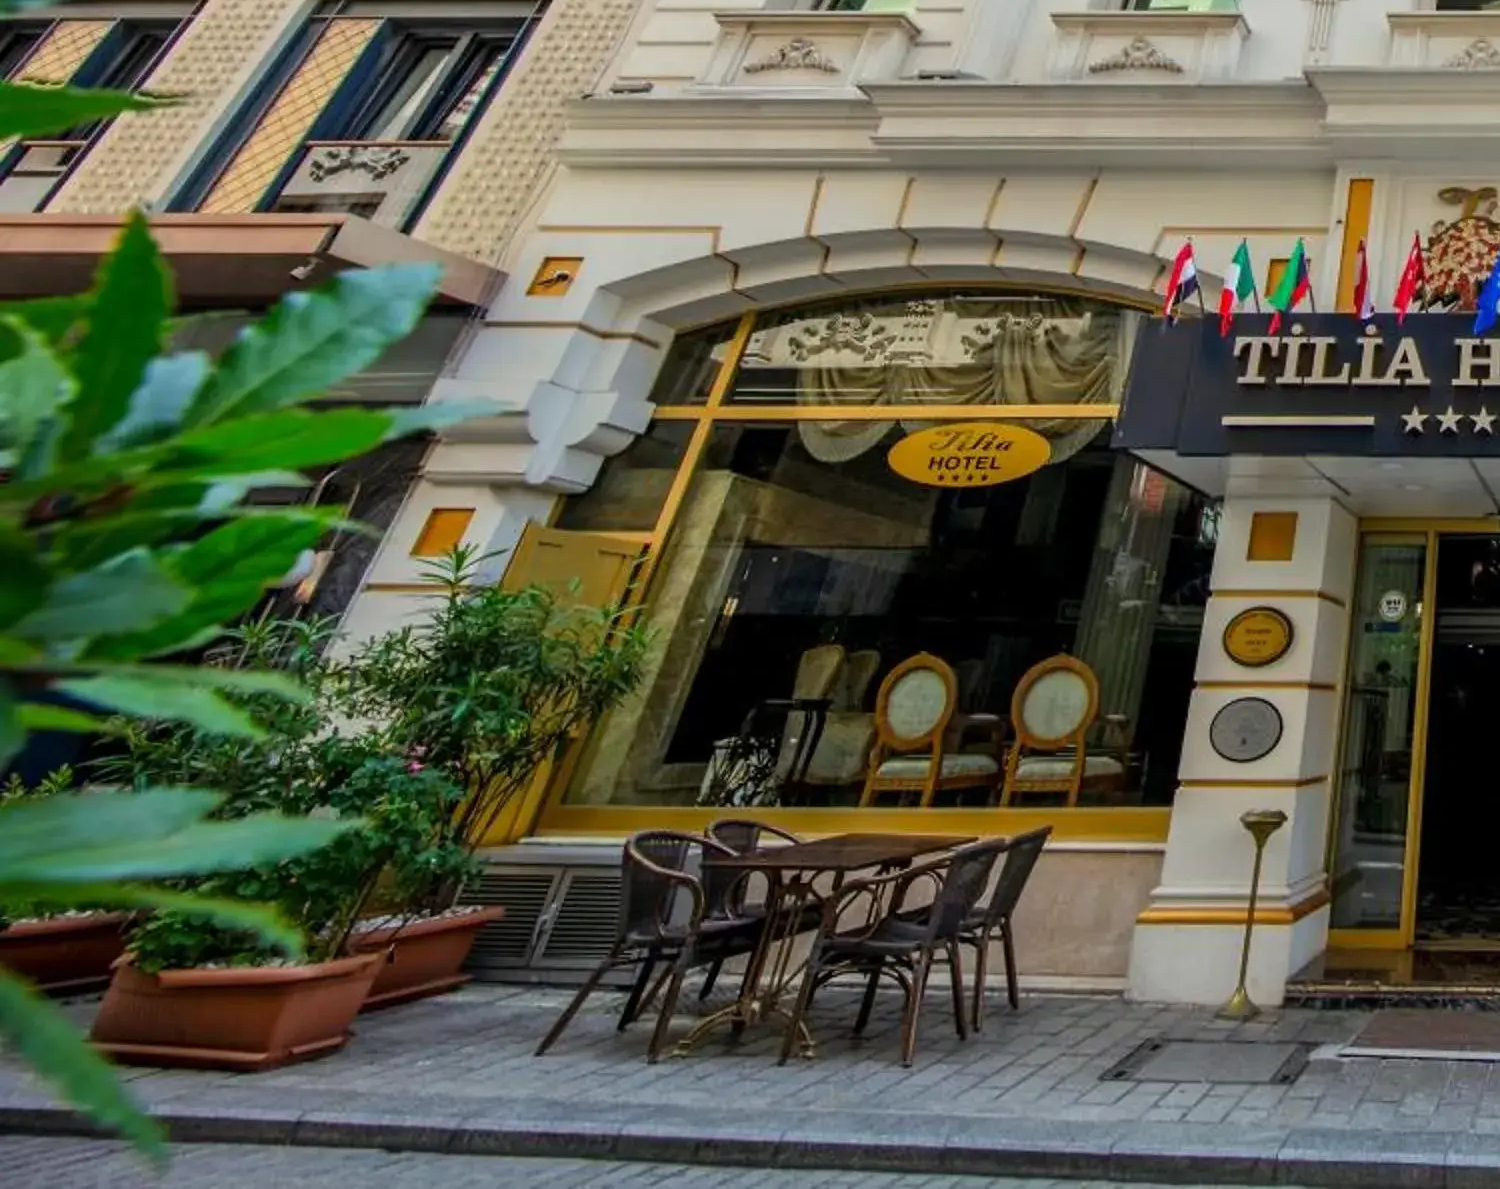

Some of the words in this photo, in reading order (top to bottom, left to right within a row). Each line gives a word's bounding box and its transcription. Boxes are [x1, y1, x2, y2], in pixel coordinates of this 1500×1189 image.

[1233, 323, 1431, 384] TİLİA
[929, 429, 1013, 452] Tilia
[928, 456, 1001, 470] HOTEL
